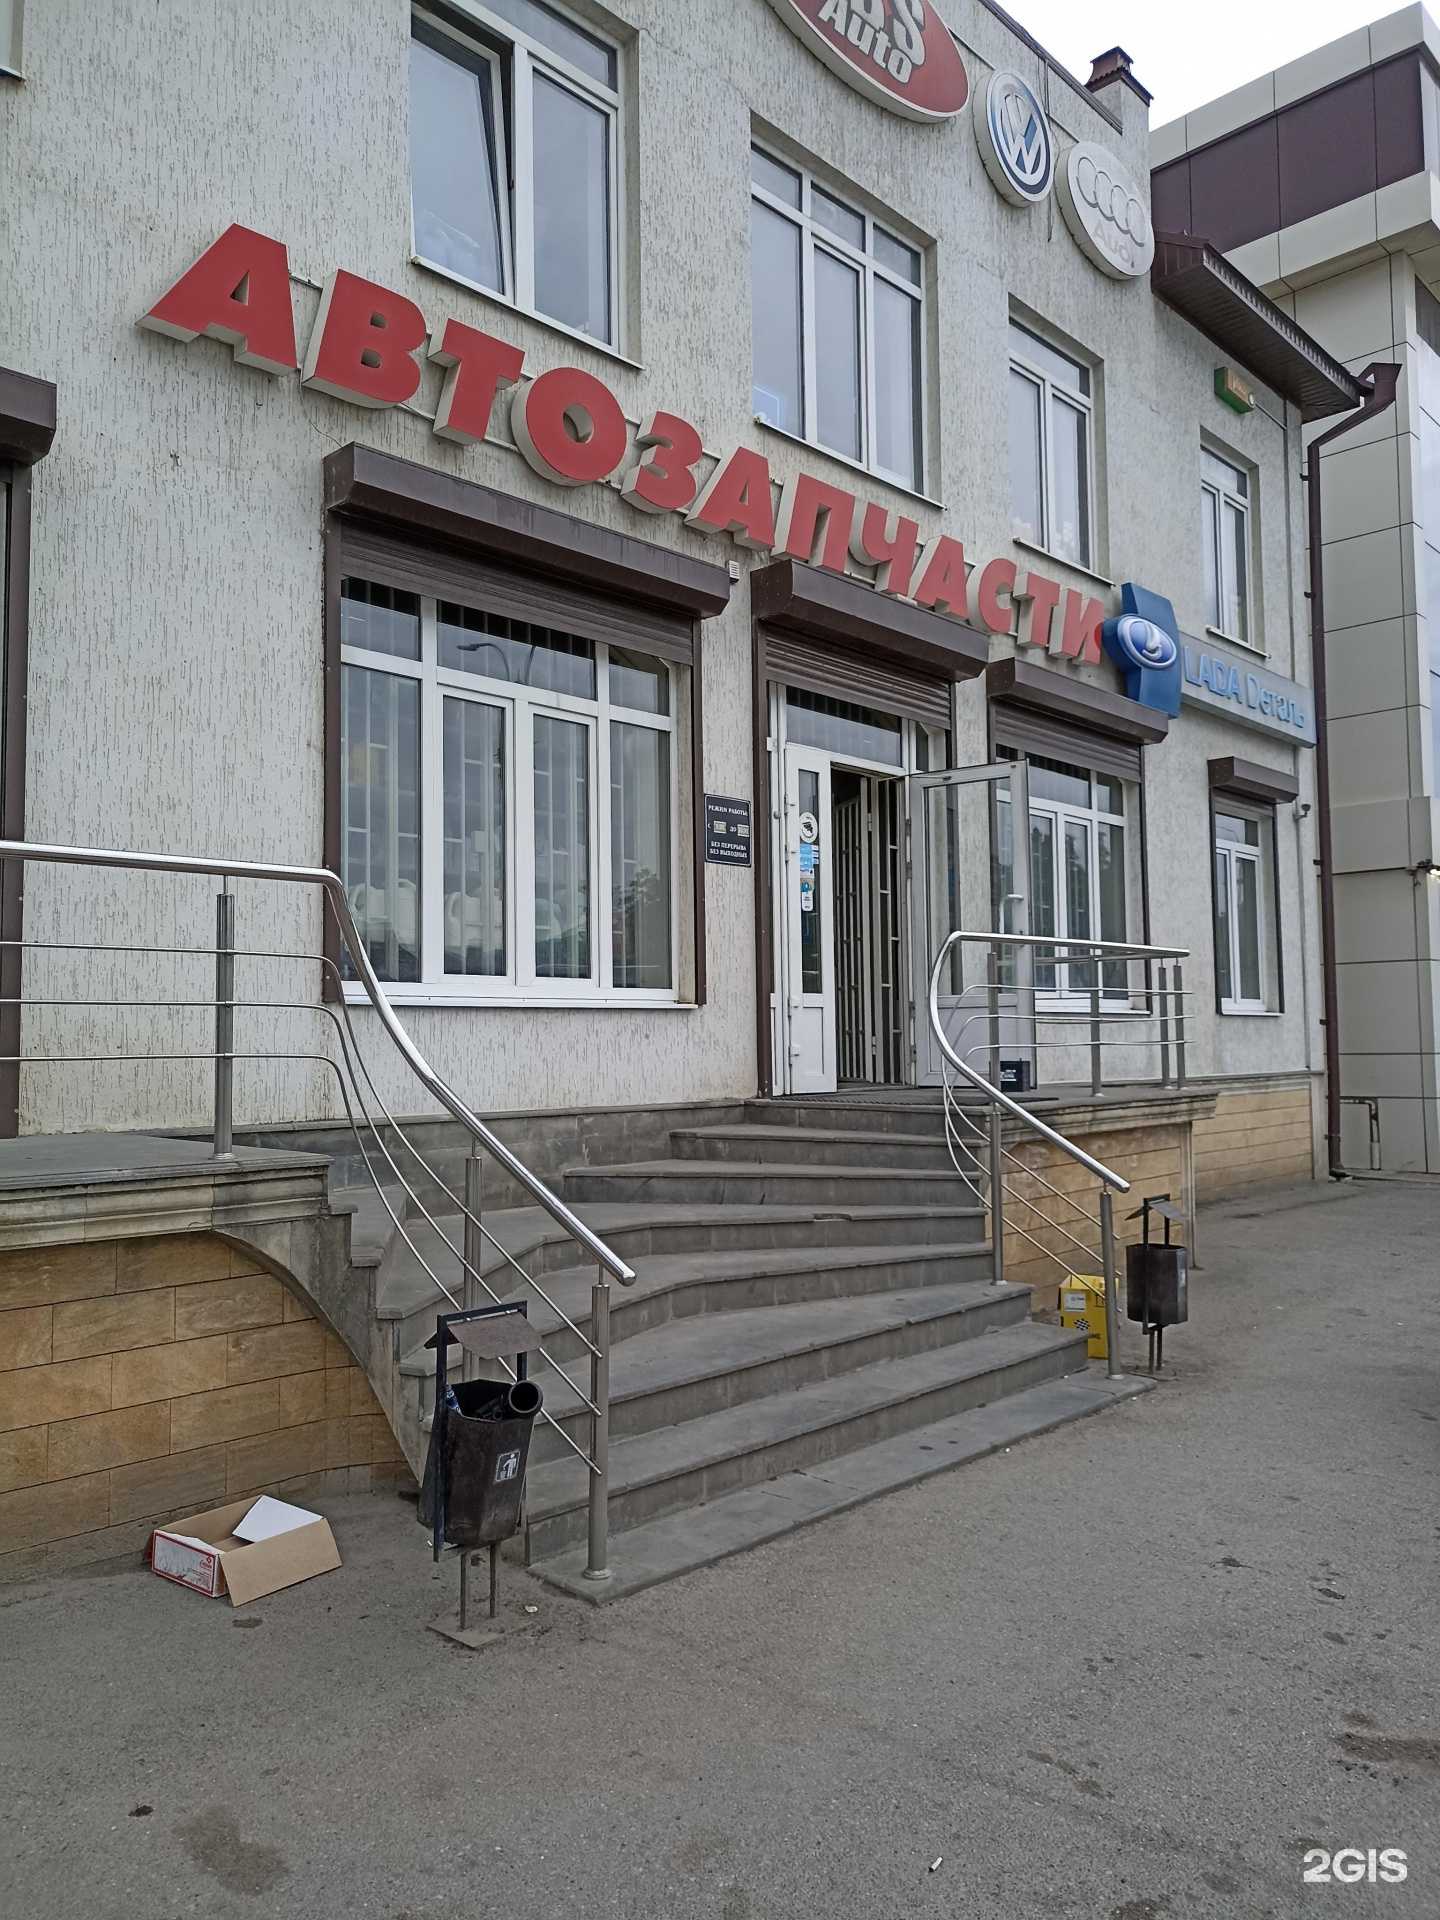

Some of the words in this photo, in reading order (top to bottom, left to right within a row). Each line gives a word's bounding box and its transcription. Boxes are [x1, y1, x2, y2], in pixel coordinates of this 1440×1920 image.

[818, 0, 912, 83] Auto
[136, 223, 1104, 666] АВТОЗАПЧАСТИ
[1183, 644, 1242, 704] LADA
